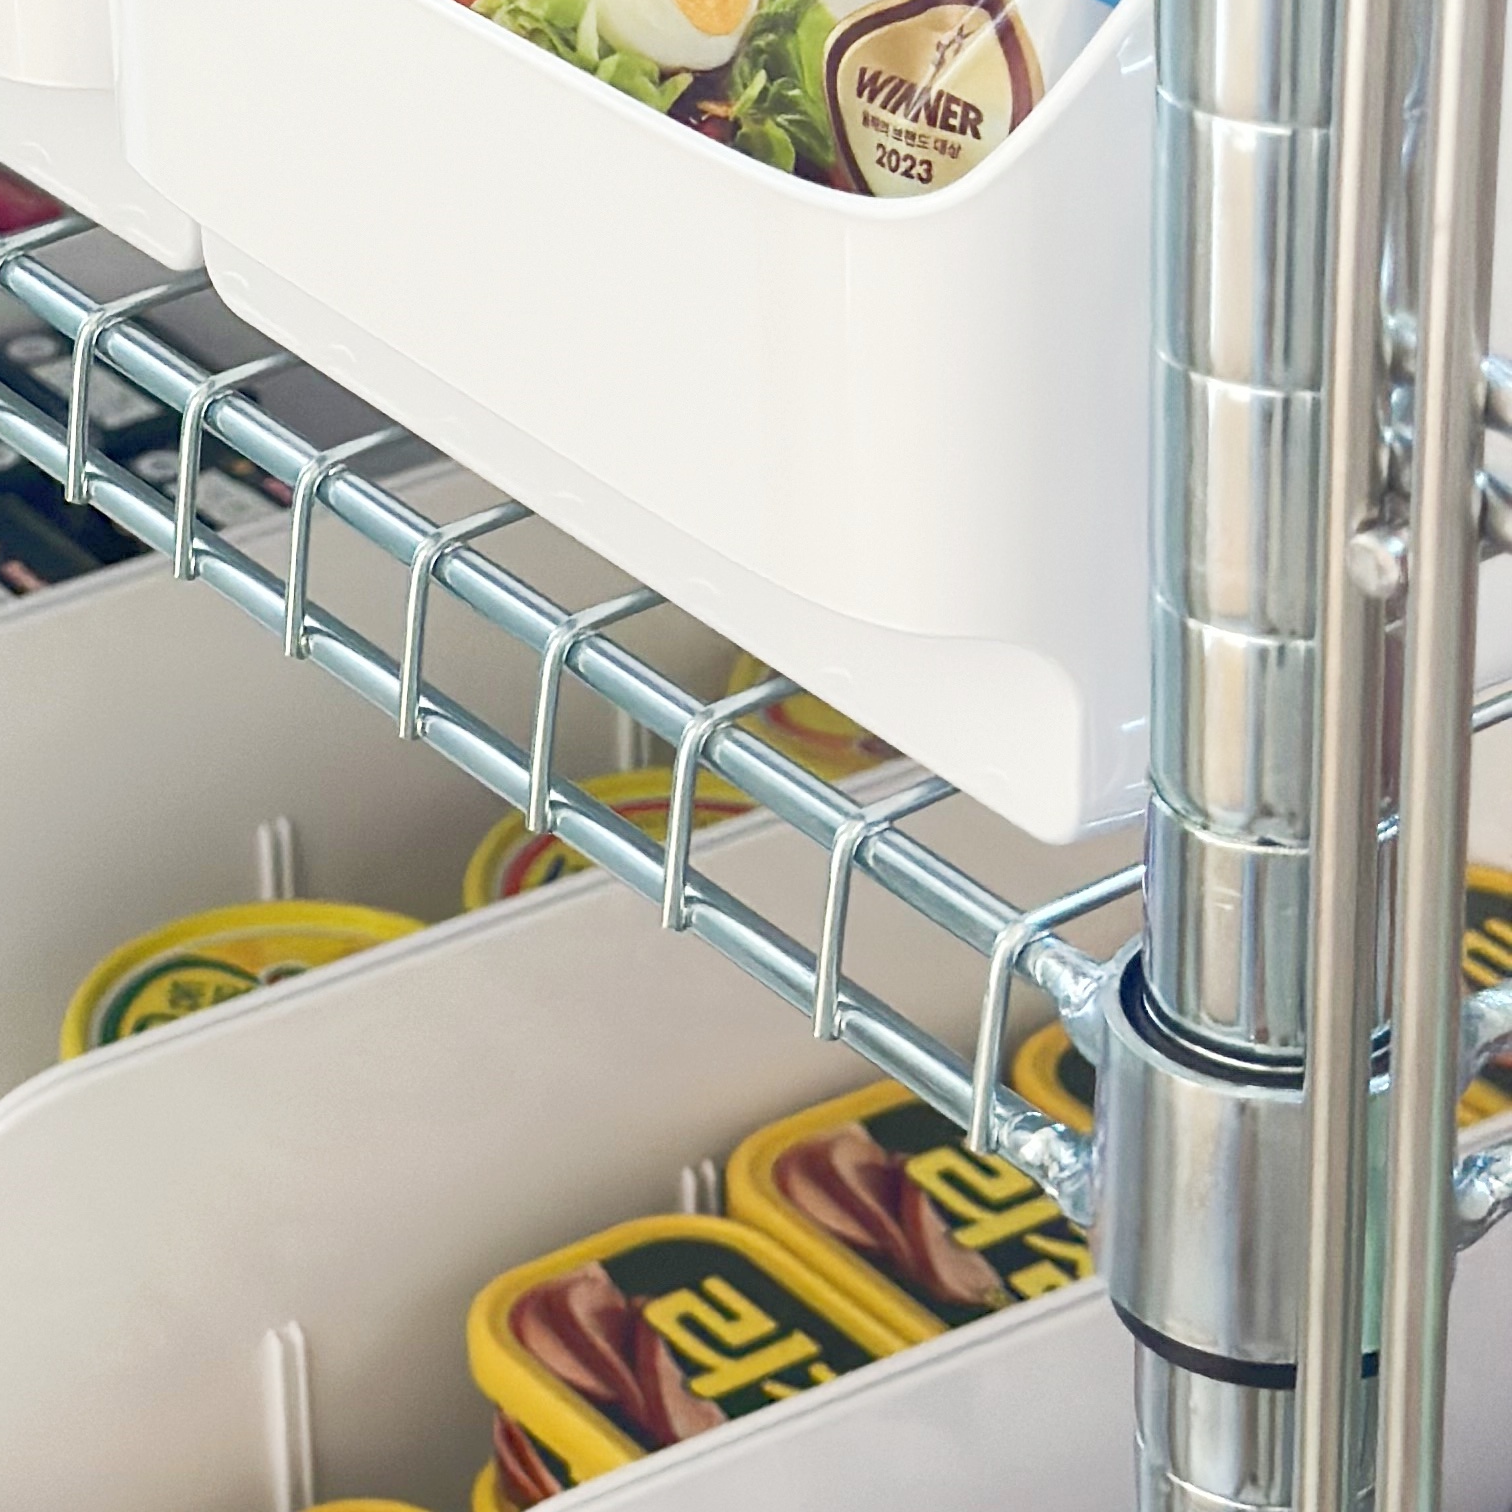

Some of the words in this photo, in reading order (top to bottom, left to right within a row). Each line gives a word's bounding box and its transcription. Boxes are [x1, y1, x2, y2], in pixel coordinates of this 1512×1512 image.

[855, 65, 984, 140] WINNER
[875, 143, 934, 185] 2023
[644, 1276, 840, 1406] 리
